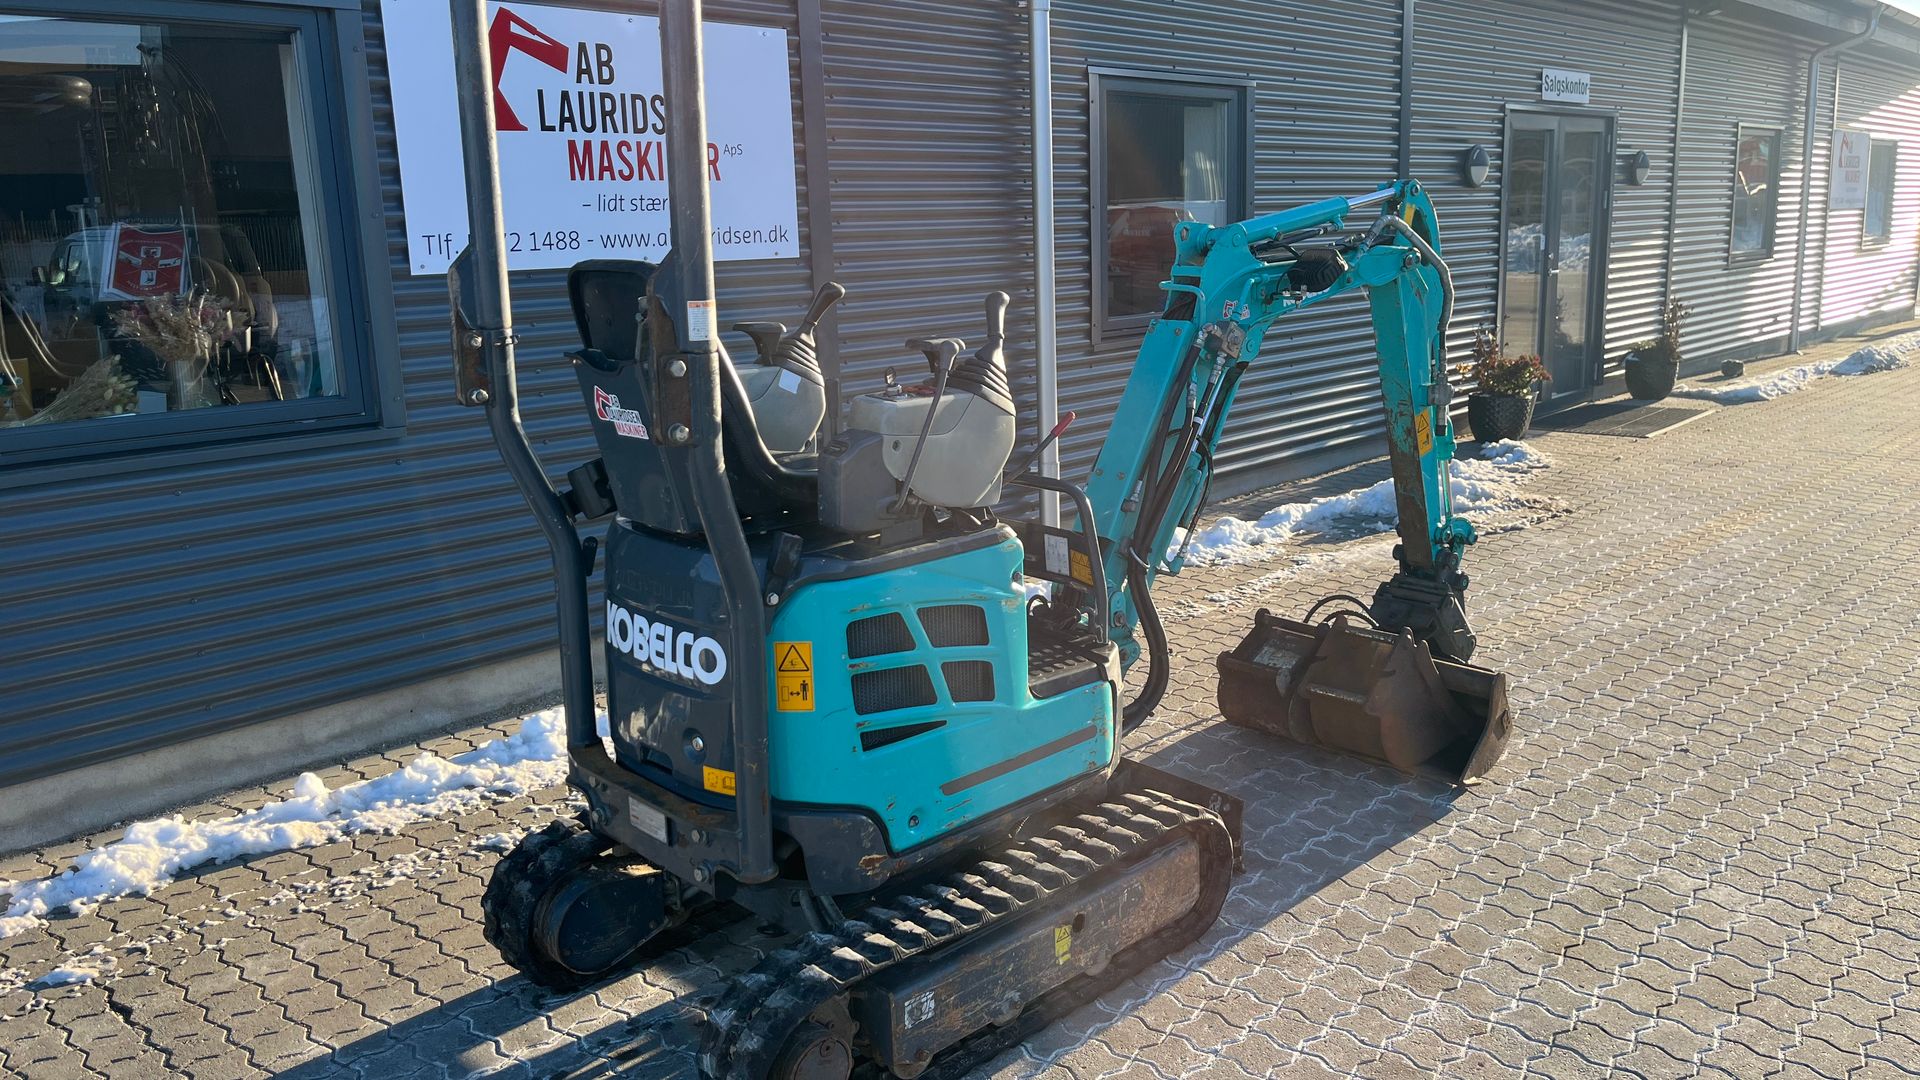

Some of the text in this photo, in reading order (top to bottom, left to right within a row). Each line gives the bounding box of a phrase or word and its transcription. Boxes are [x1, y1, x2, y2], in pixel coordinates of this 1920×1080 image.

[575, 41, 616, 86] AB
[1543, 74, 1589, 97] Salgskontor
[536, 88, 667, 136] LAURIDS
[567, 139, 743, 182] MASKIR ApS
[597, 193, 625, 212] lidt
[630, 194, 669, 212] stær
[421, 232, 459, 261] Tlf.
[529, 230, 581, 252] 1488
[600, 224, 790, 249] www.aridsen.dk
[606, 599, 728, 686] KOBELCO
